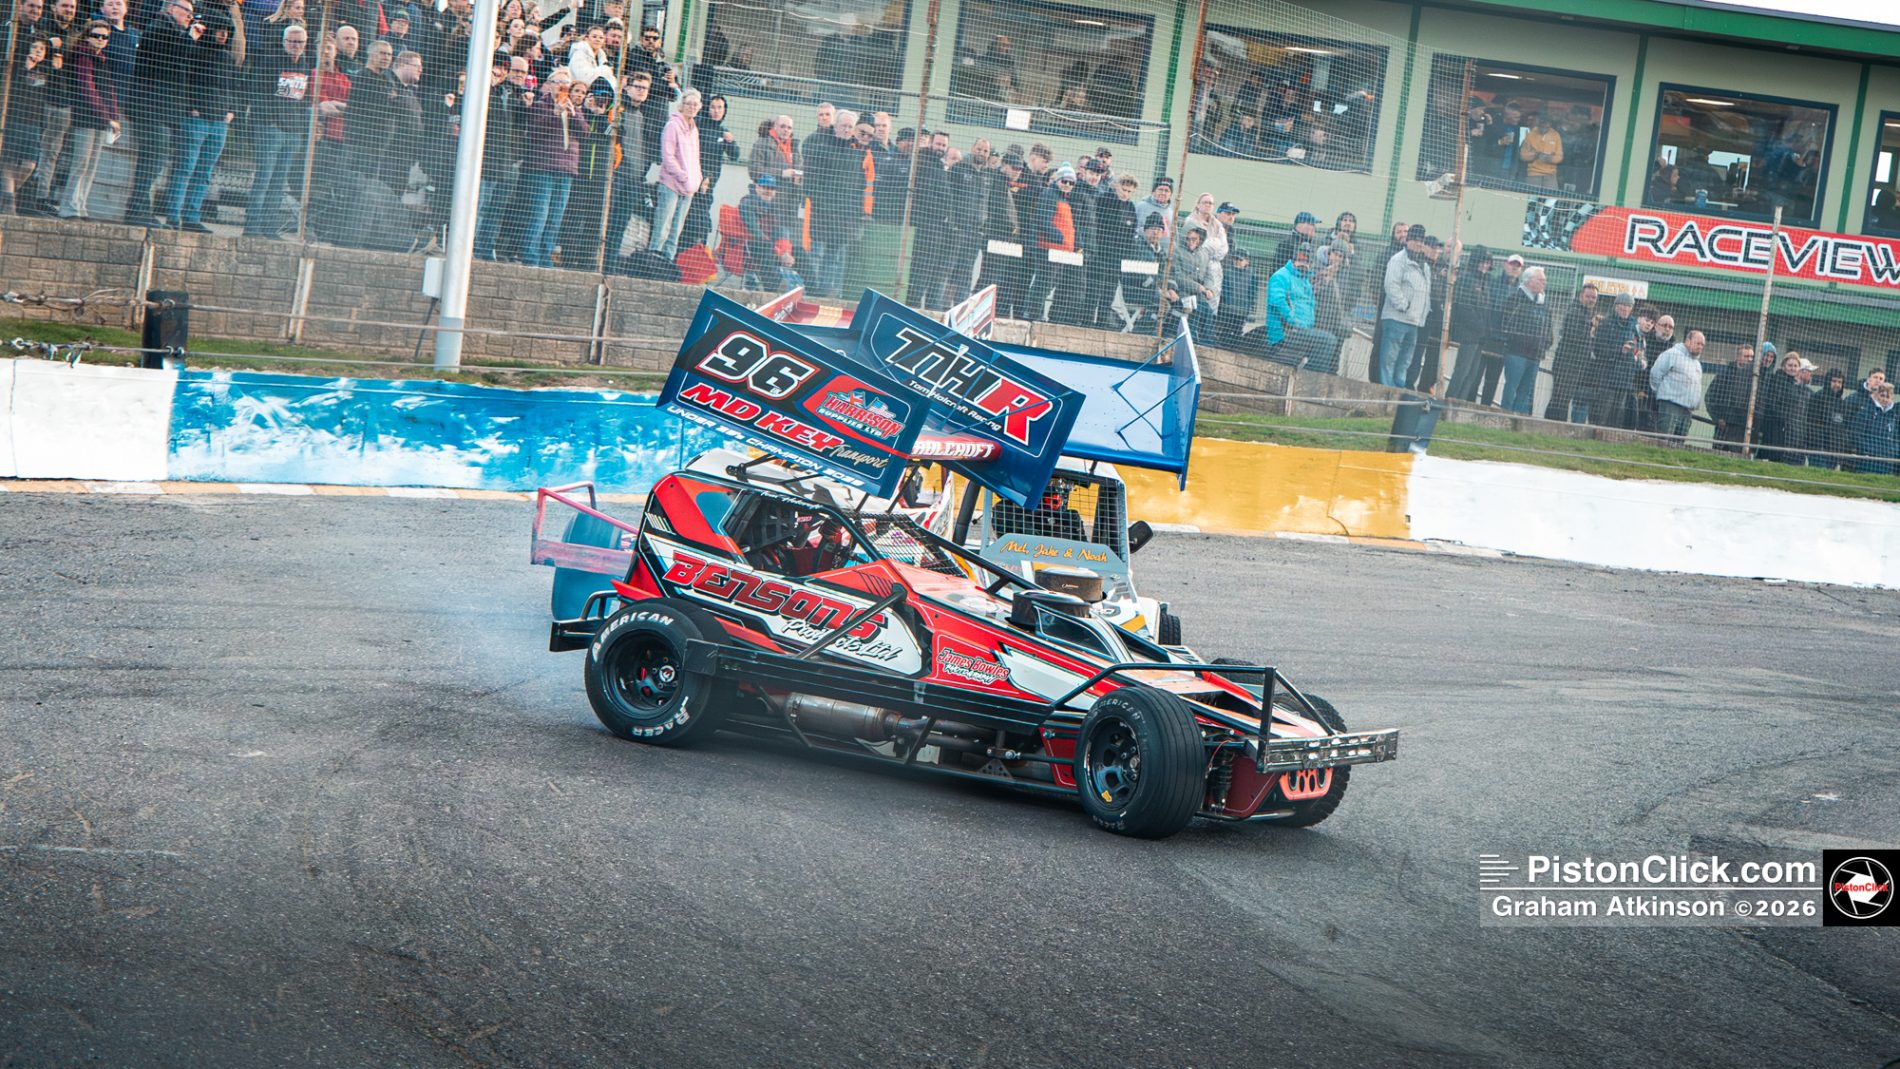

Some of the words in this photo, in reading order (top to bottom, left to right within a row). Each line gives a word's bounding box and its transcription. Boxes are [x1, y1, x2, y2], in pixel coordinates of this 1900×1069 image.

[1623, 213, 1900, 285] RACEVIEW
[697, 332, 817, 398] 96
[885, 327, 1053, 446] THR
[908, 380, 930, 396] Tom
[680, 382, 761, 422] MD
[755, 410, 845, 453] KEY
[819, 407, 864, 432] SUPPLIES
[823, 396, 905, 439] HARRISON
[667, 405, 717, 428] UNDER
[746, 438, 823, 470] CHAMPION
[831, 444, 889, 470] Transport
[1033, 543, 1059, 558] Jake
[1063, 548, 1073, 559] &
[1077, 549, 1108, 563] Noah
[592, 611, 675, 663] AMERICAN
[781, 620, 862, 652] Prodcts
[938, 649, 973, 669] James
[971, 658, 1010, 679] Bowles
[632, 706, 691, 737] RACER
